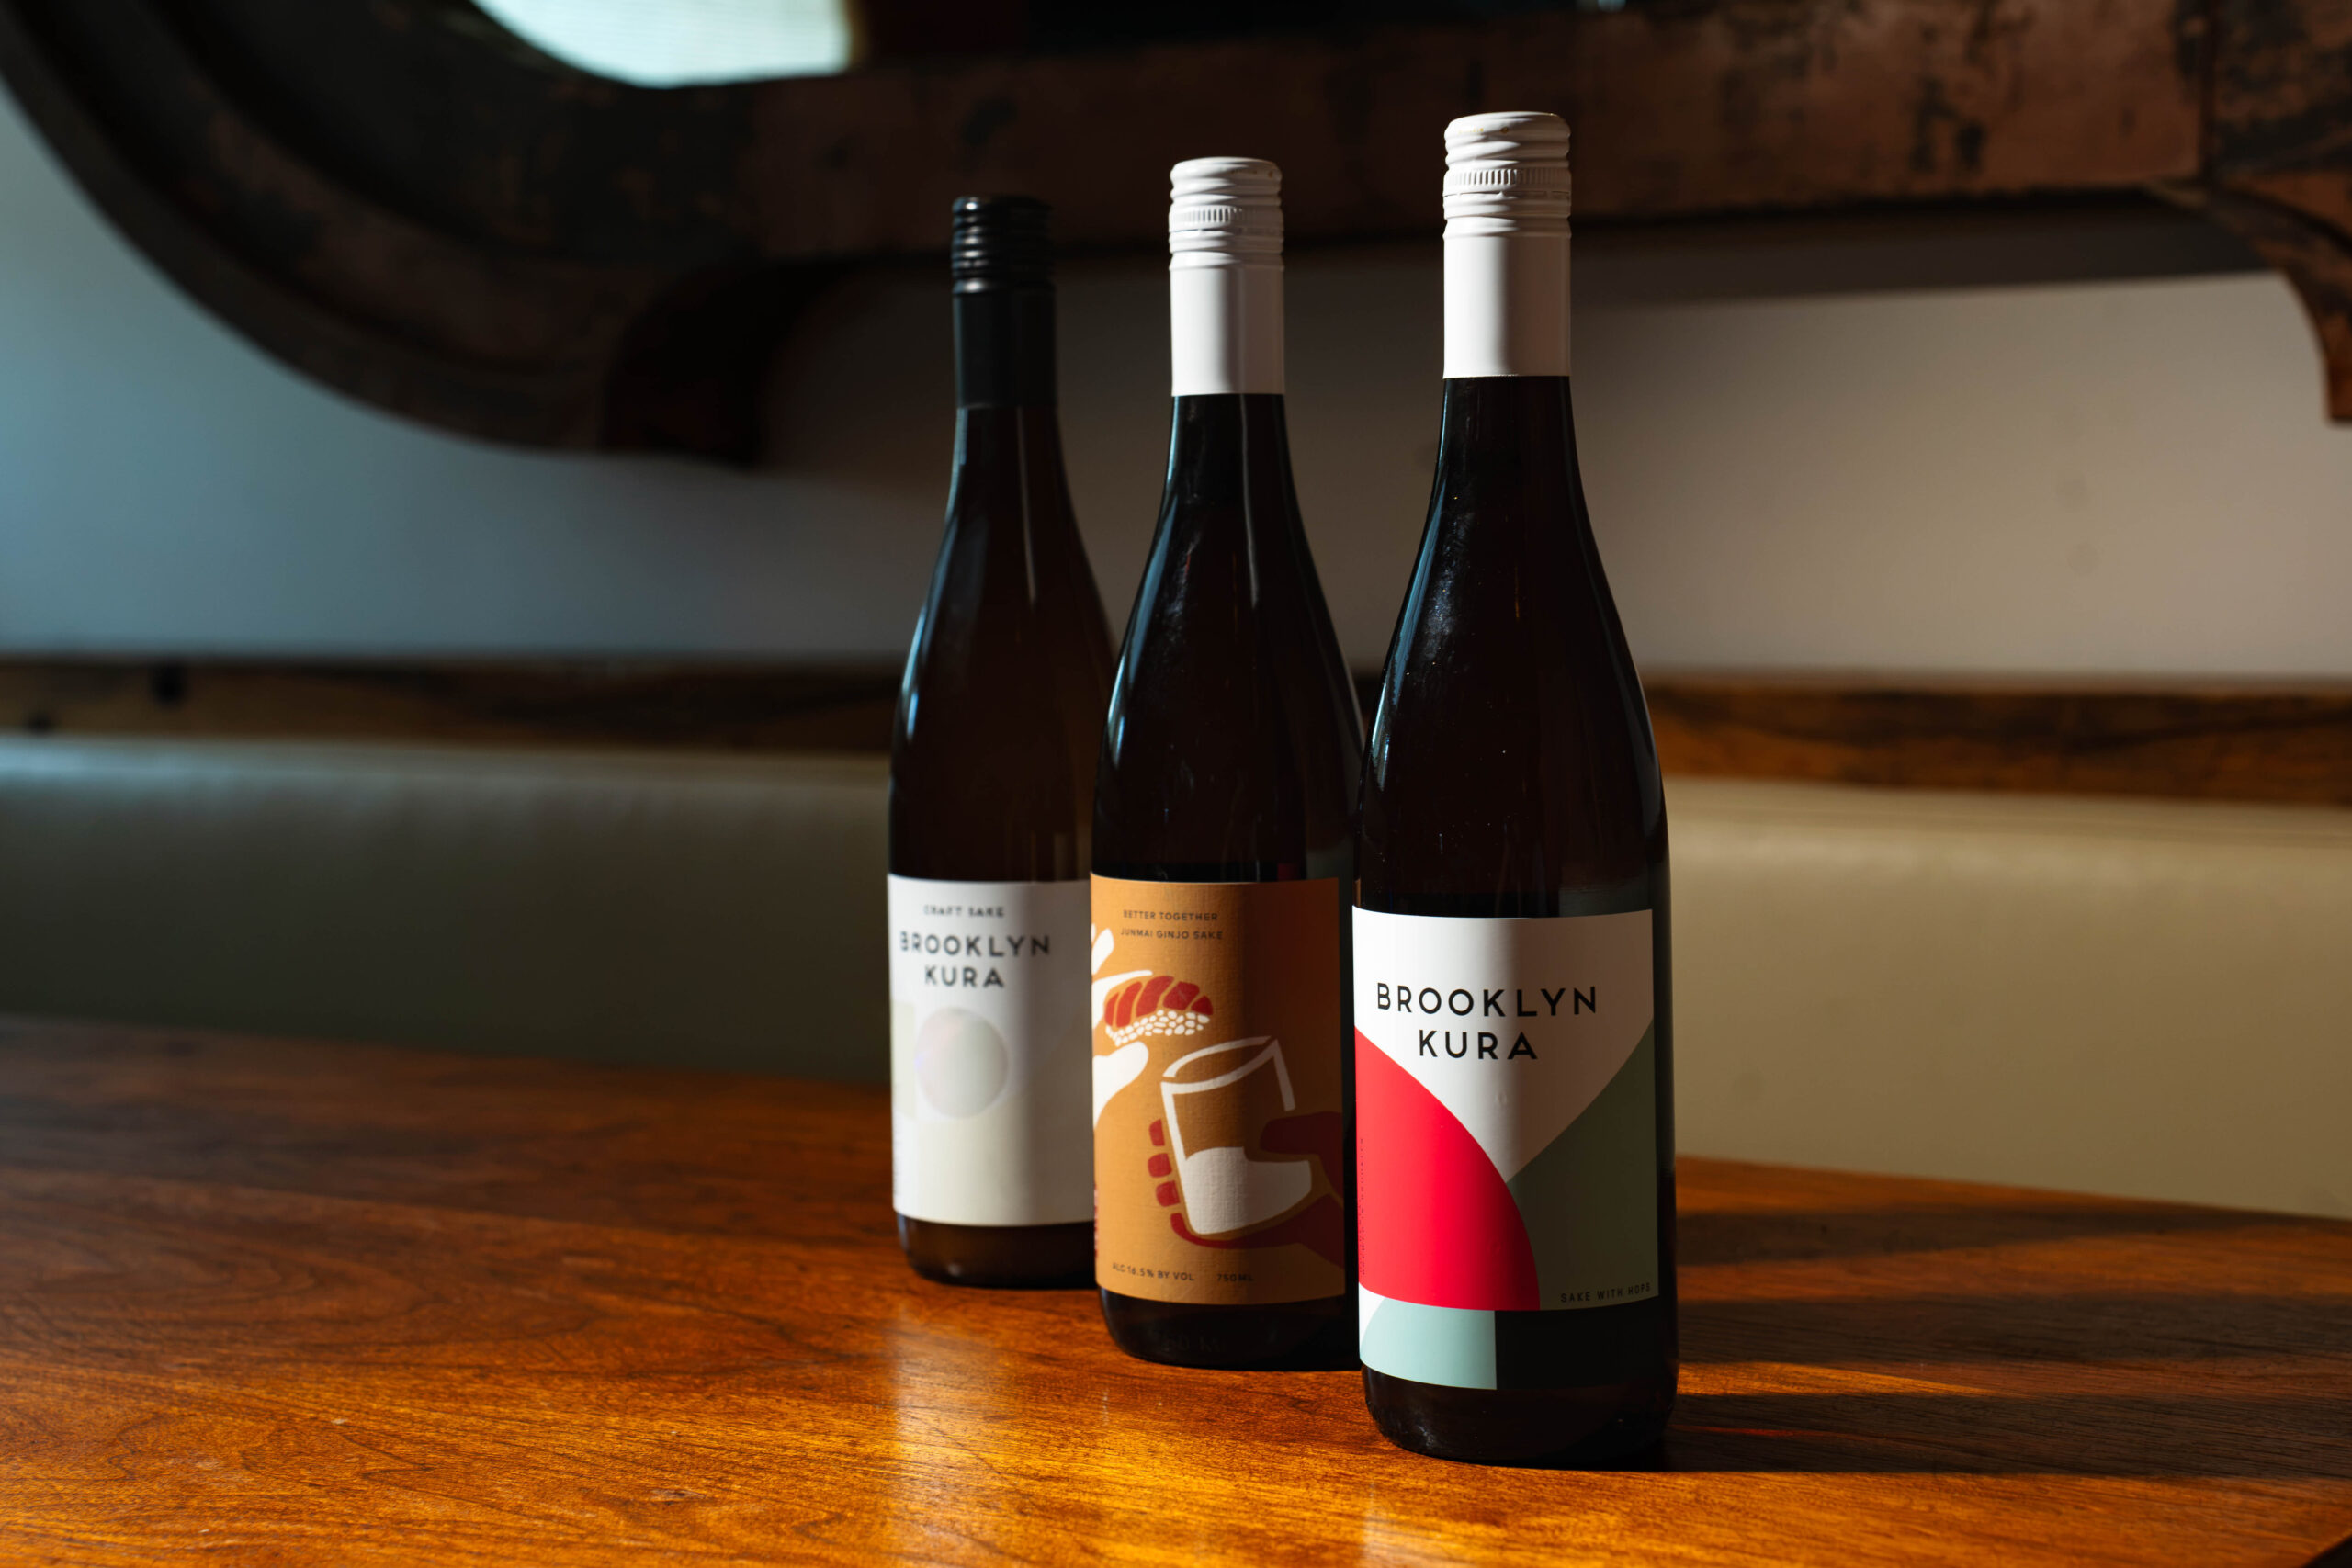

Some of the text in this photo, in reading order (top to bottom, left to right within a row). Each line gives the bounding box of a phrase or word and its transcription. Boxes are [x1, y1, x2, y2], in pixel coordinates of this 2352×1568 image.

[967, 905, 1005, 918] SAKE
[1123, 909, 1218, 921] BETTER TOGETHER
[899, 930, 1050, 957] BROOKLYN
[1120, 928, 1224, 940] JUNMAI GINJO SAKE
[924, 965, 1005, 988] KURA
[1377, 982, 1596, 1017] BROOKLYN
[1419, 1029, 1538, 1060] KURA
[1158, 1270, 1170, 1280] BY
[1172, 1271, 1195, 1281] VOL
[1560, 1282, 1651, 1303] SAKE WITH HOPS
